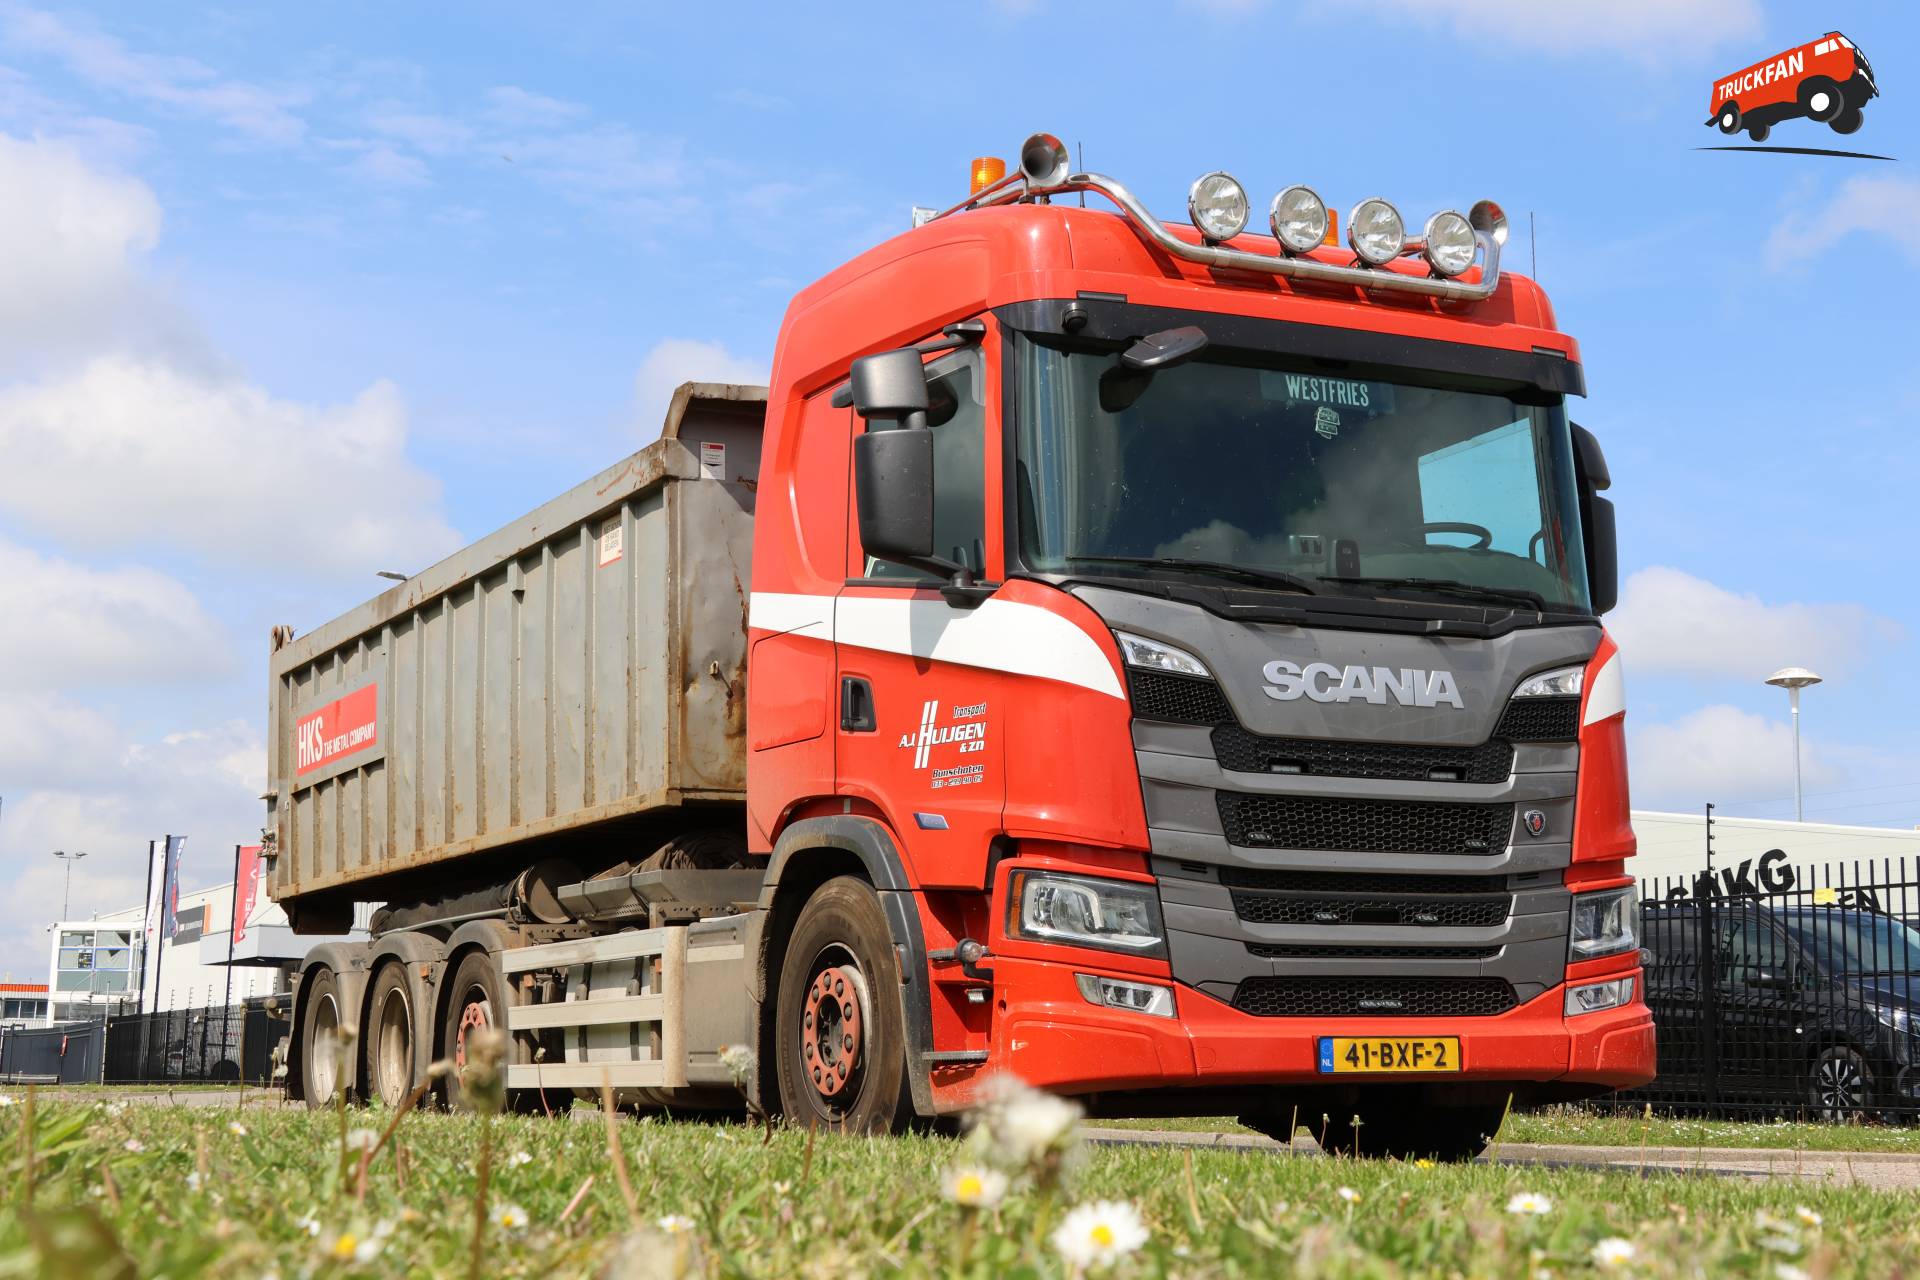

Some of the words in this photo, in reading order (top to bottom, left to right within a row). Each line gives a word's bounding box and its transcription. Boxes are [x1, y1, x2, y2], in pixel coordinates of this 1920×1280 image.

[1286, 375, 1369, 407] WESTFRIES
[1262, 660, 1465, 709] SCANIA
[952, 703, 987, 718] Transport
[298, 716, 323, 768] HKS
[324, 741, 333, 757] THE
[333, 734, 350, 754] METAL
[350, 722, 376, 747] COMPANY
[1322, 1058, 1333, 1067] NL
[1345, 1042, 1447, 1068] 41-BXF-2
